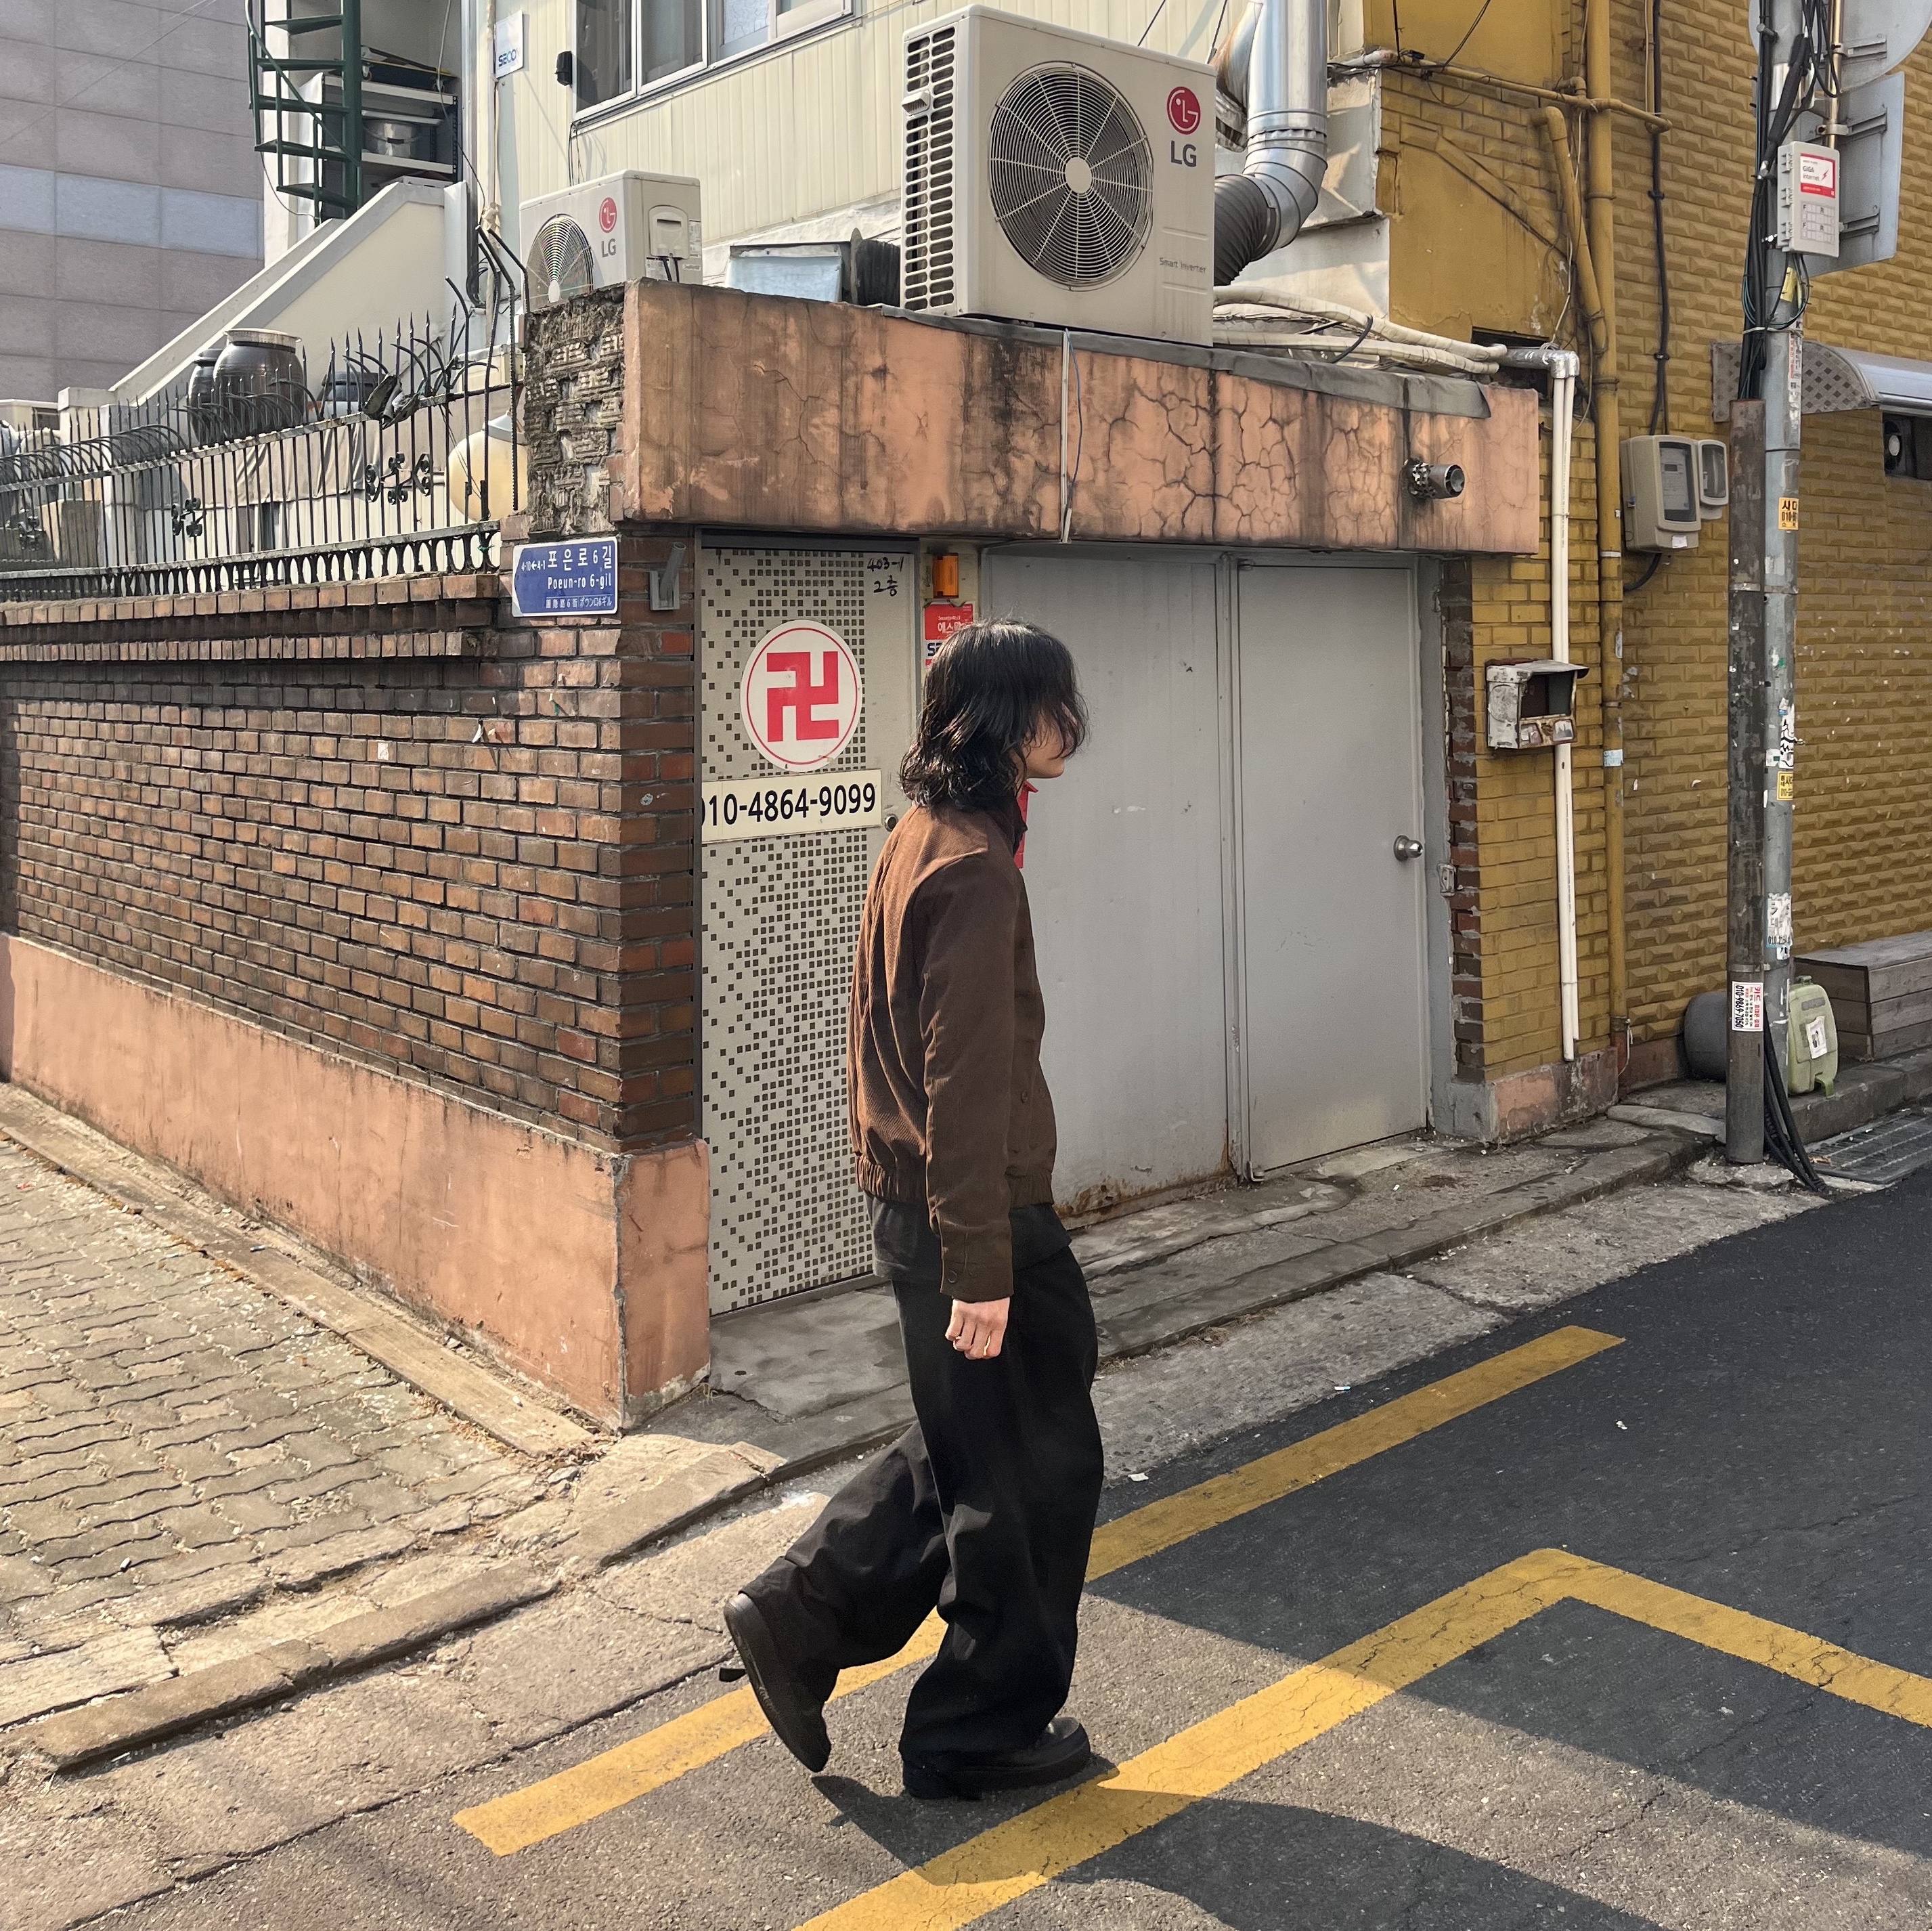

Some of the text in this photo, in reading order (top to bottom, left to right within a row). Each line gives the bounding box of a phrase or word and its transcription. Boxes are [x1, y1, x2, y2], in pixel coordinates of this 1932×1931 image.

[499, 49, 519, 67] SECO
[1170, 140, 1197, 167] LG
[601, 238, 617, 258] LG
[1159, 257, 1178, 268] Smart
[867, 557, 904, 572] 403-1
[548, 573, 612, 590] Poeun-ro 6-gil
